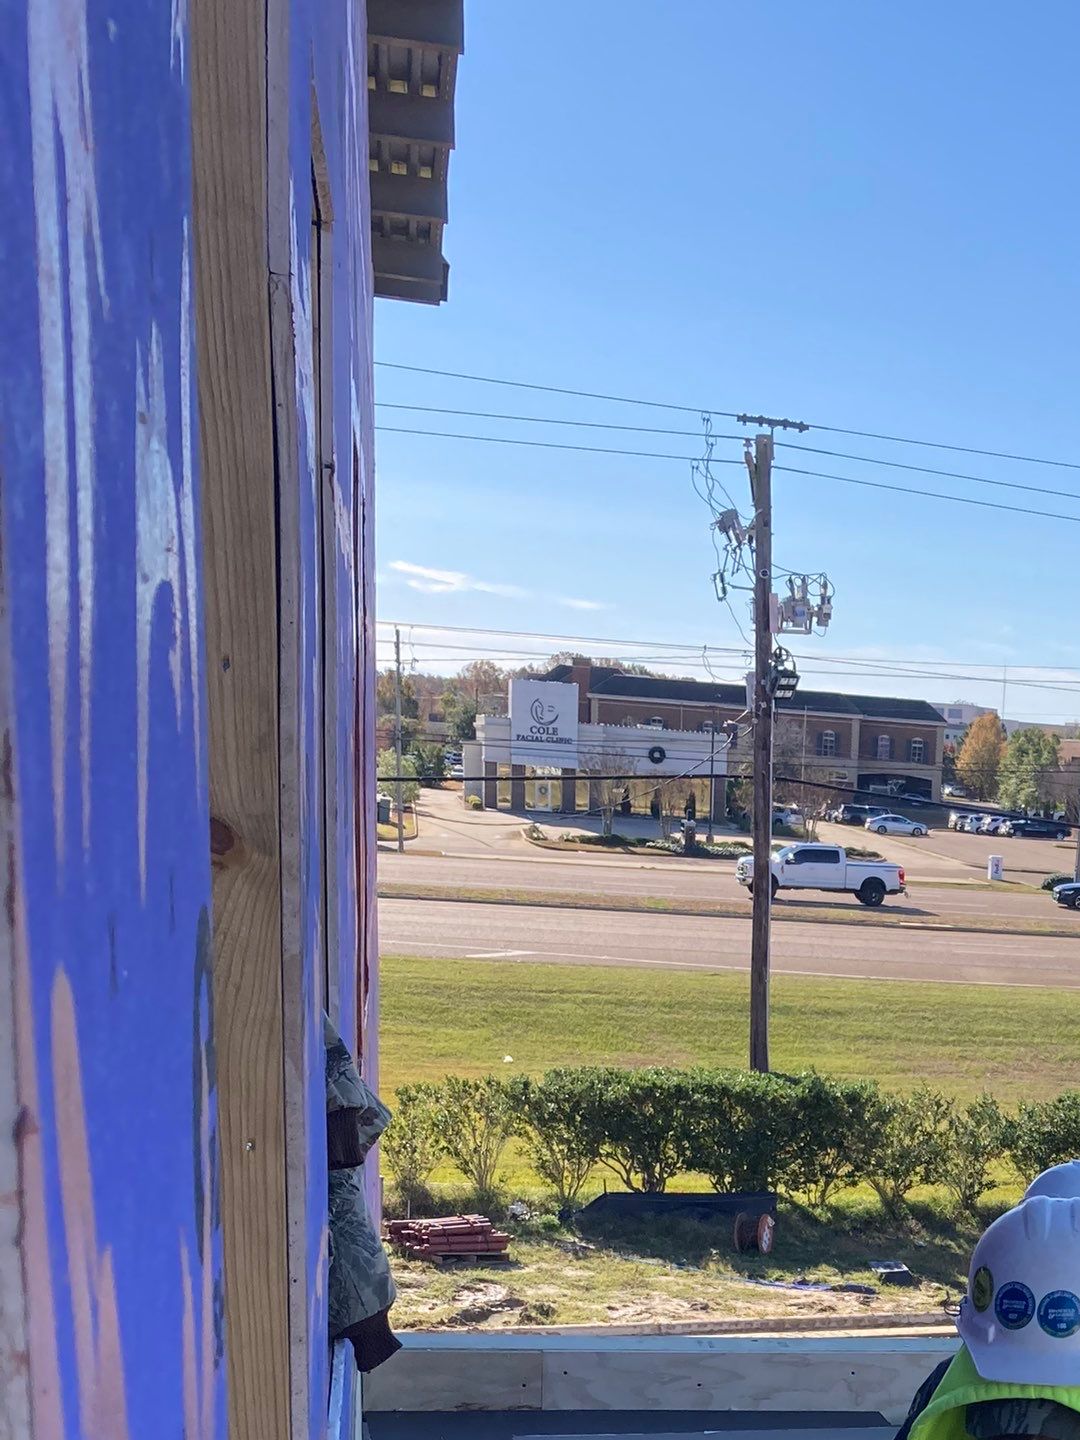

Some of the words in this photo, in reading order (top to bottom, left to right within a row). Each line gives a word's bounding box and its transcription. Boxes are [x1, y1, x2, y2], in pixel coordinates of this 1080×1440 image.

[530, 725, 559, 736] COLE
[516, 734, 545, 743] FACIAL
[546, 736, 573, 745] CLINIC
